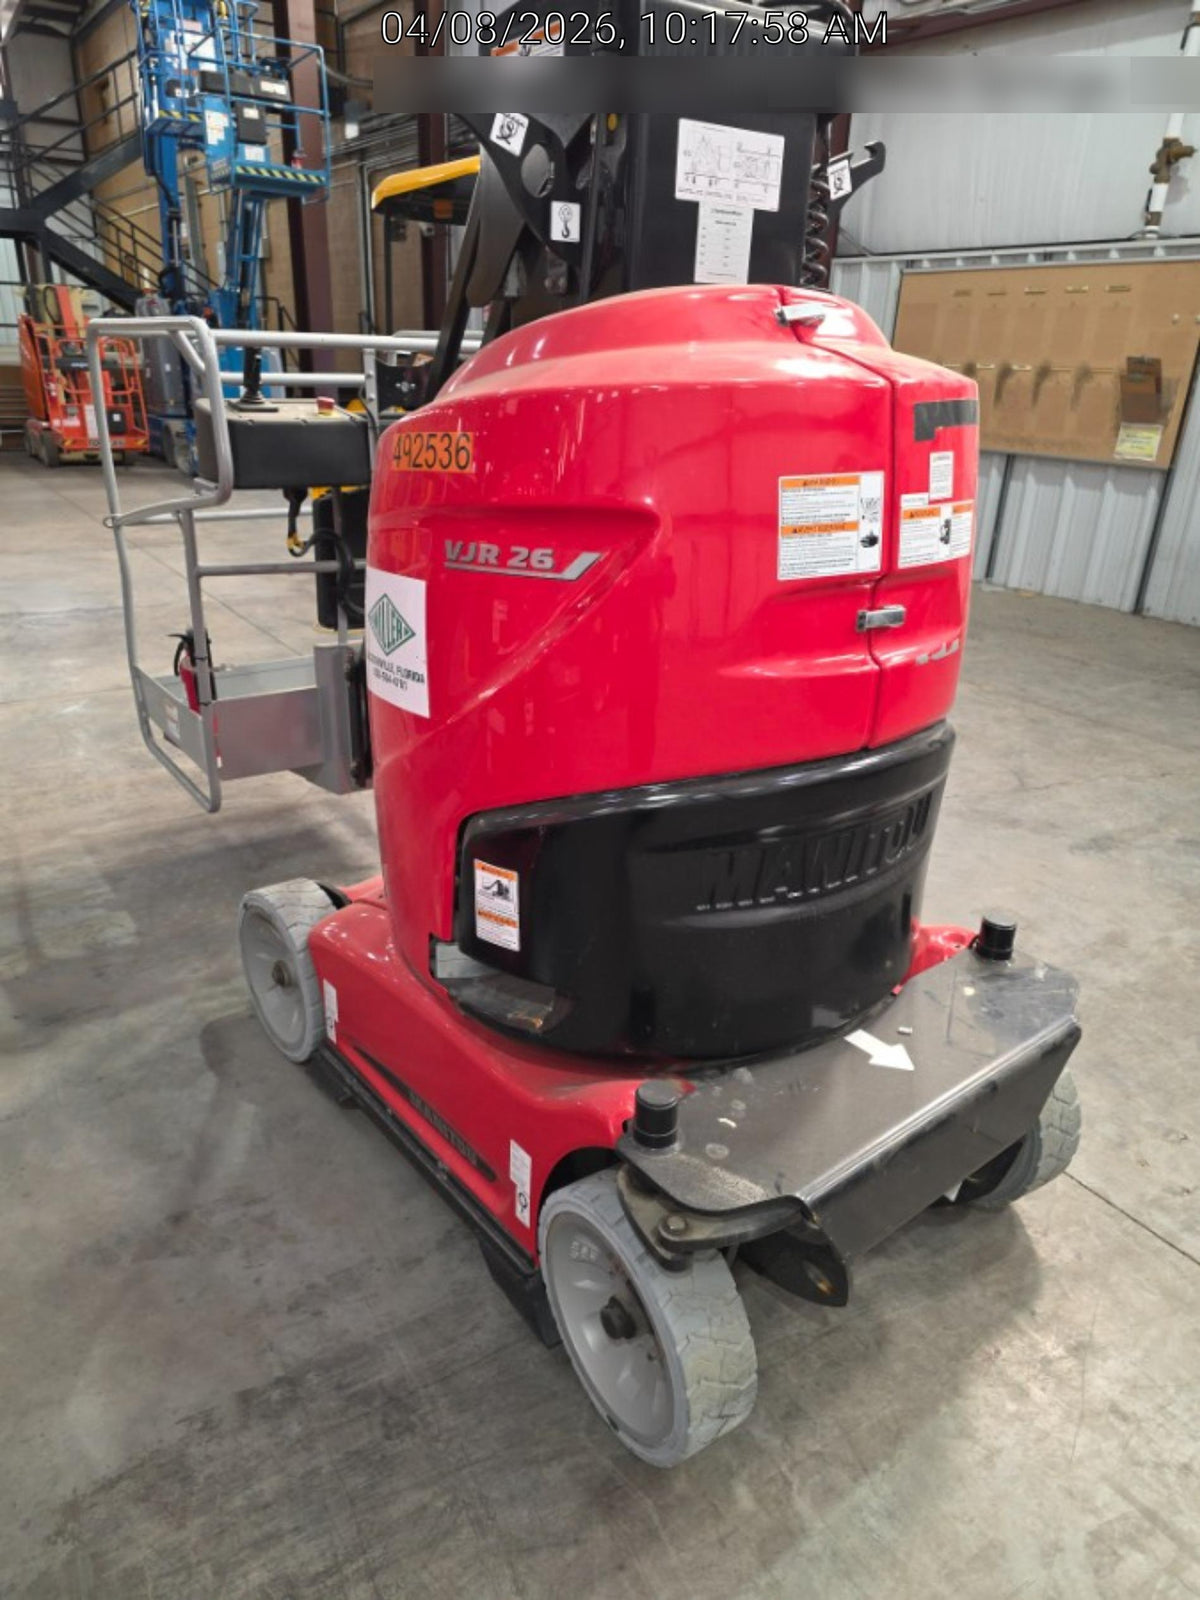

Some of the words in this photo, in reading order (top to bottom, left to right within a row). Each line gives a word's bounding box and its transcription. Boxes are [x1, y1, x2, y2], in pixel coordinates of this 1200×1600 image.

[393, 433, 471, 471] 492536
[444, 540, 500, 565] VJR
[507, 546, 554, 570] 26
